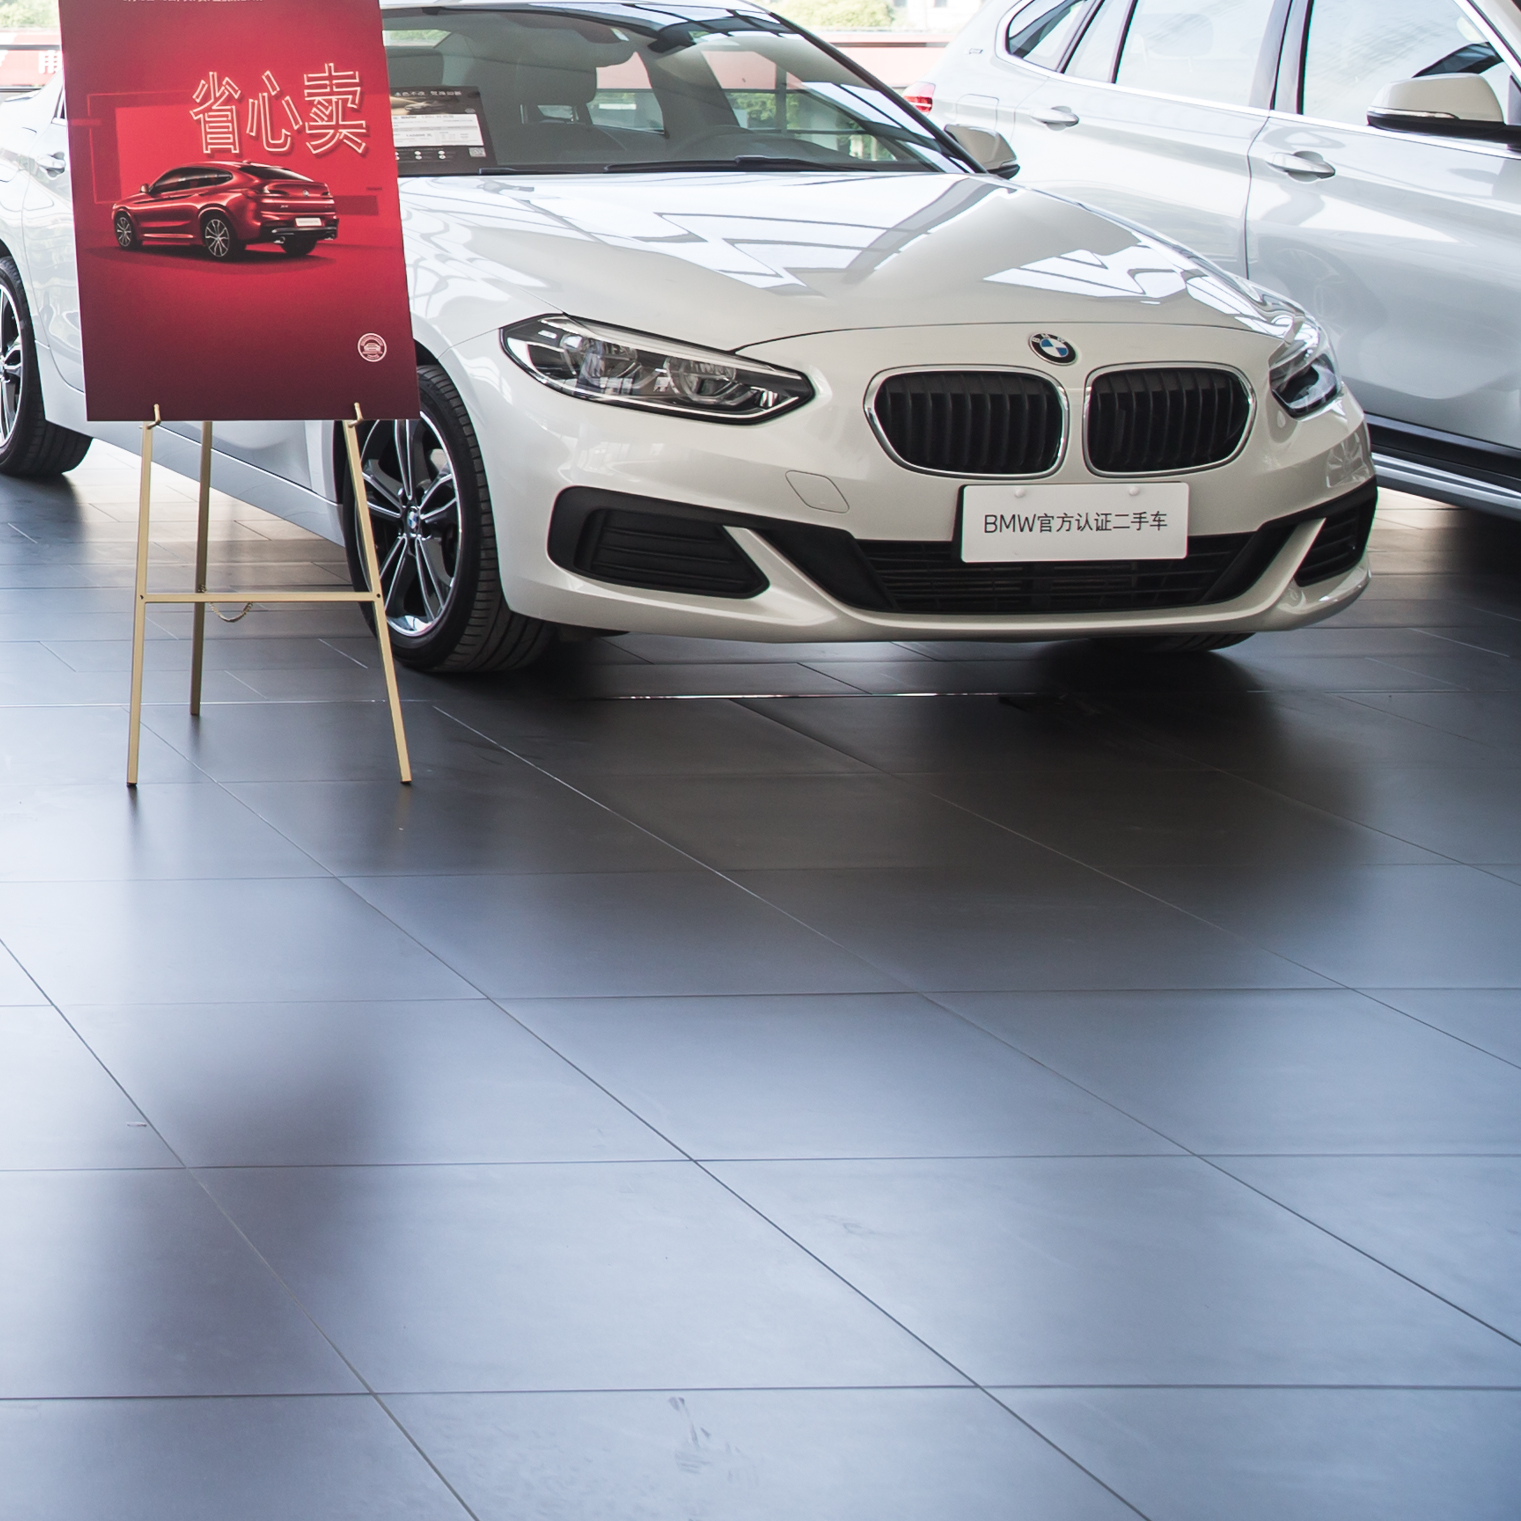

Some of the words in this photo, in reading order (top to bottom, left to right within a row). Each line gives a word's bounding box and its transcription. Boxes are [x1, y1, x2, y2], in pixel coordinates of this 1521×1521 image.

[189, 62, 366, 155] 省心卖
[983, 511, 1168, 534] BMW官方认证二手车
